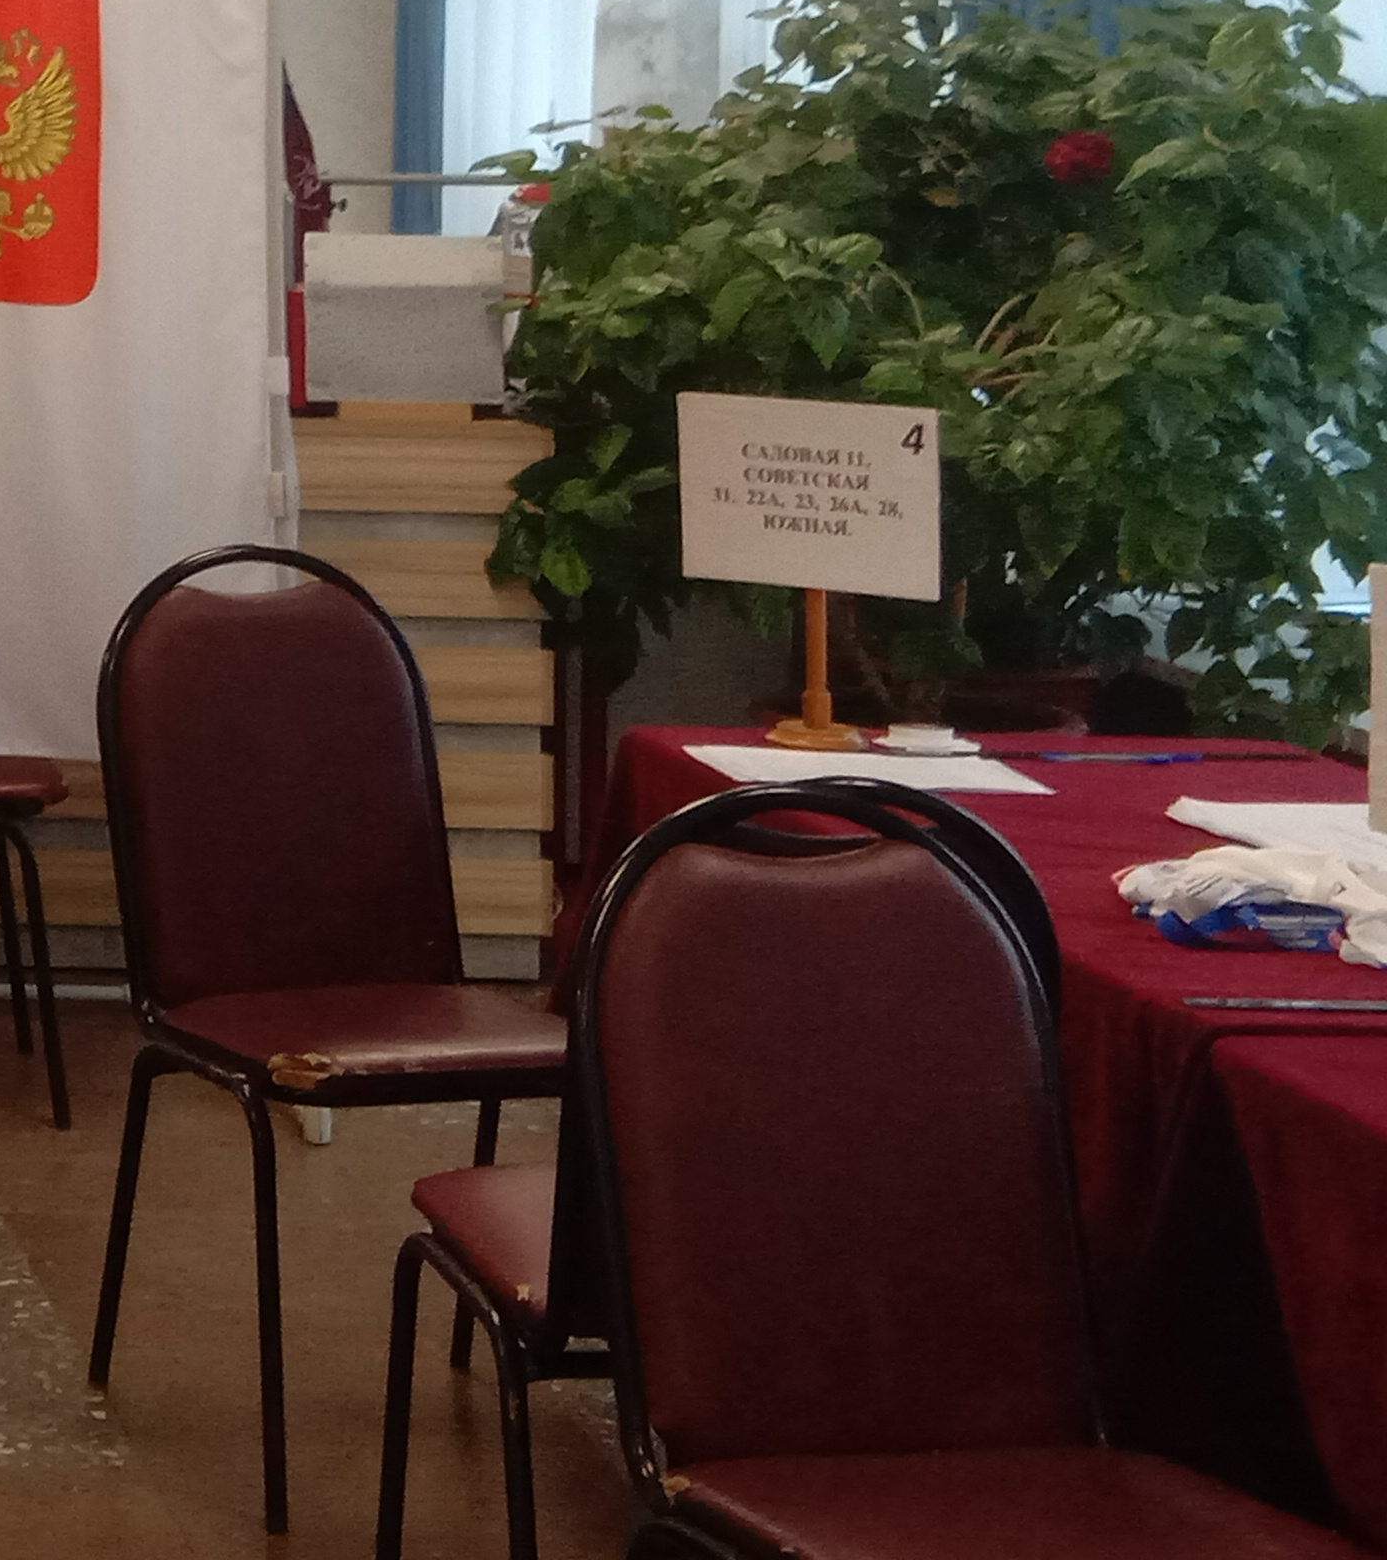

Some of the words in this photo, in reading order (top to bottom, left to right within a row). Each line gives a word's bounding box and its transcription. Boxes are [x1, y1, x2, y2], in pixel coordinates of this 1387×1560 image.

[901, 423, 925, 455] 4
[741, 443, 840, 465] САДОВАЯ
[743, 467, 870, 491] СОВЕТСКАЯ
